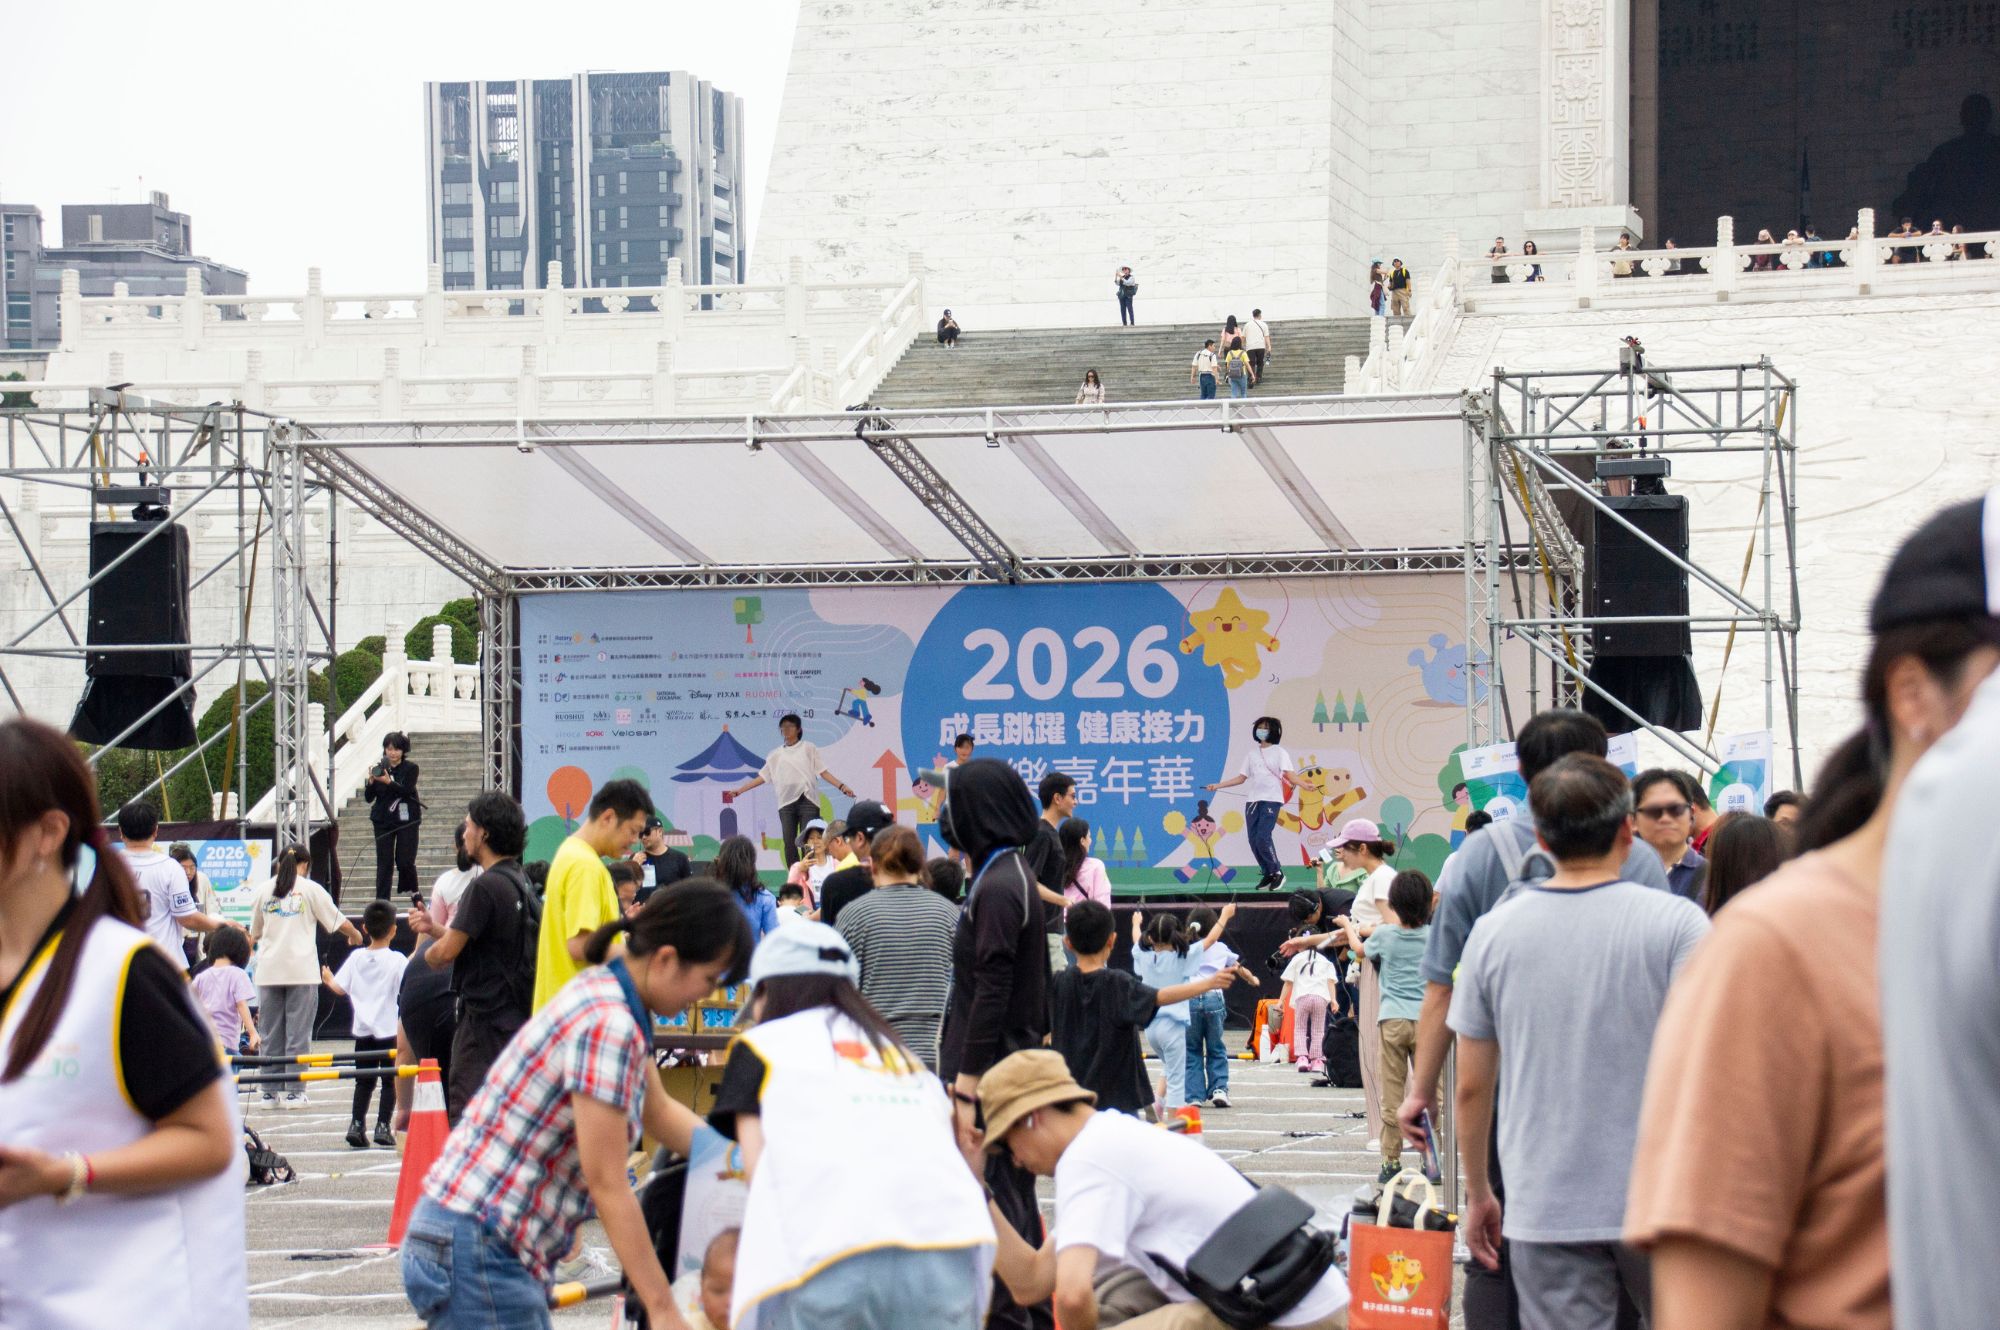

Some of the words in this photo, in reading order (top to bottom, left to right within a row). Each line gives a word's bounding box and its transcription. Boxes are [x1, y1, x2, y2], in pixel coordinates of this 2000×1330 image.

[962, 624, 1179, 700] 2026
[688, 689, 712, 700] Disney
[716, 690, 740, 698] PIXAR
[745, 690, 782, 698] RUOMEI
[611, 729, 658, 737] Velosan
[939, 712, 1066, 746] 成長跳躍
[1077, 709, 1205, 744] 健康接力
[1006, 754, 1194, 805] 樂嘉年華
[206, 846, 244, 860] 2026
